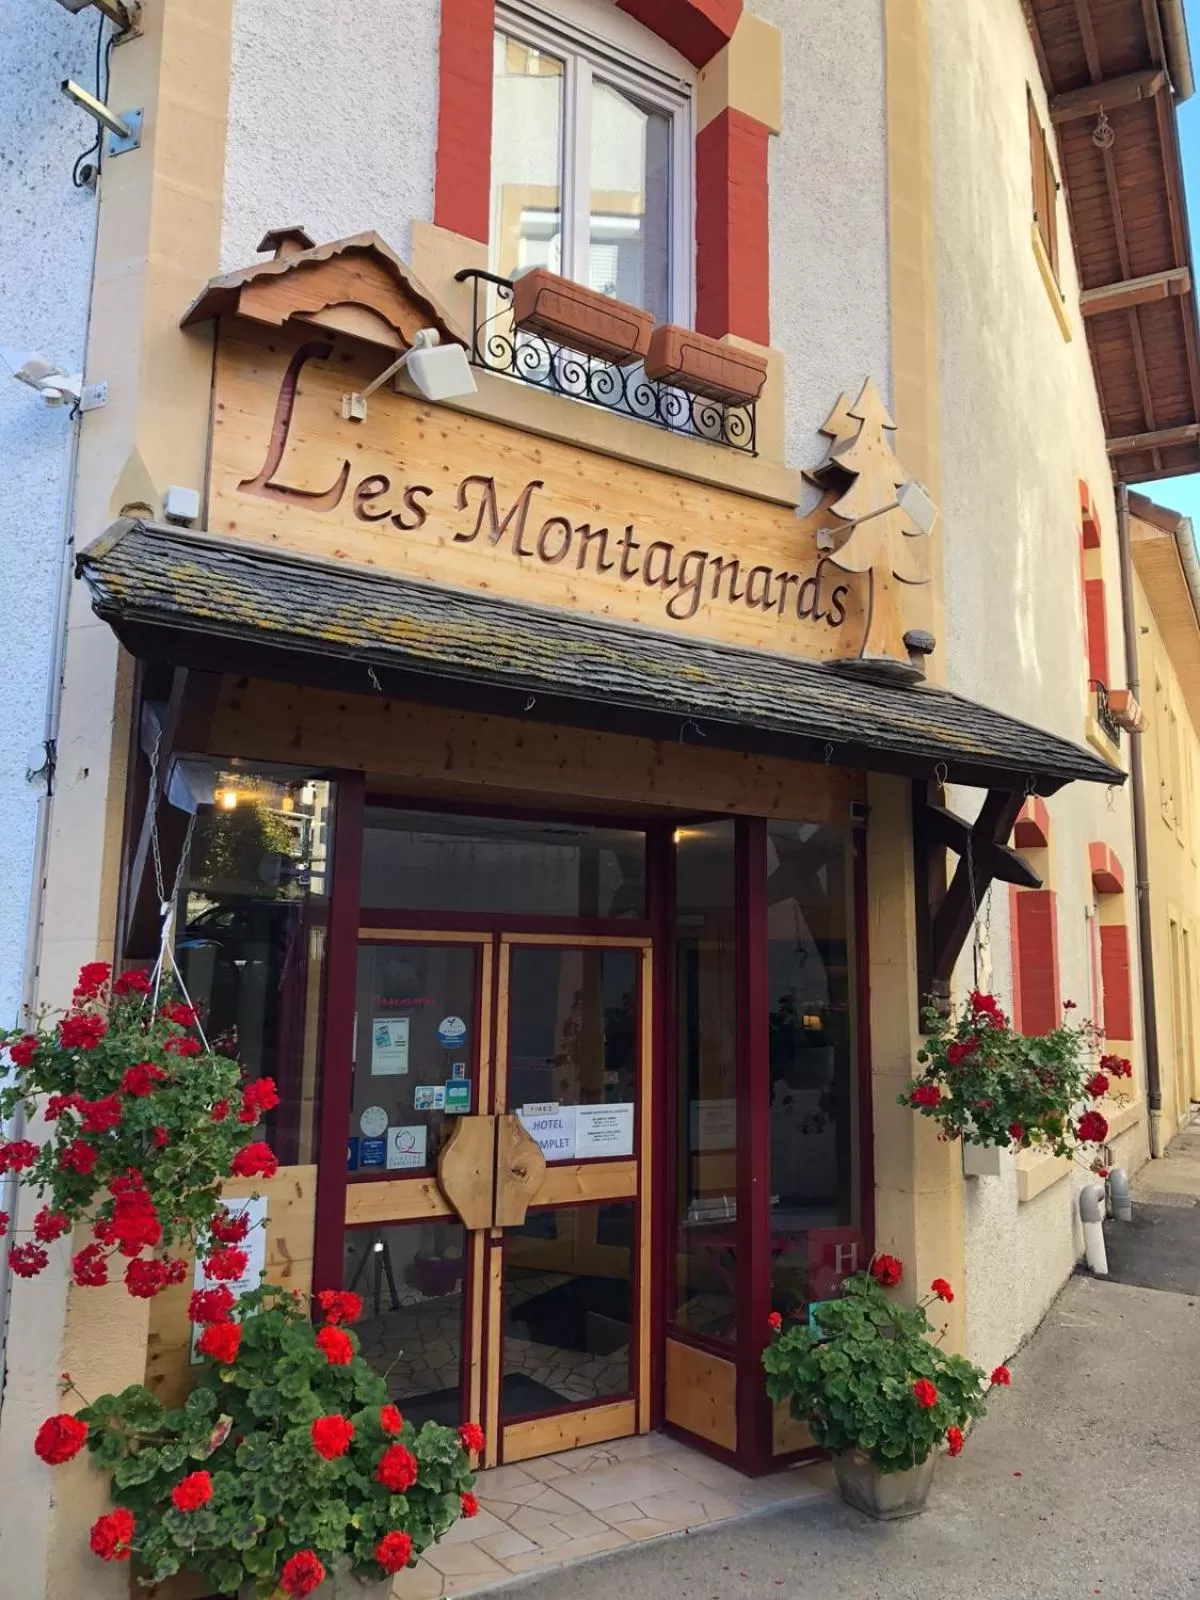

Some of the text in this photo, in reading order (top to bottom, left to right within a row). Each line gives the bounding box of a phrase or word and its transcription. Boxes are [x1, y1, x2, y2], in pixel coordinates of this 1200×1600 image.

[237, 340, 850, 628] Les Montagnards
[533, 1119, 564, 1131] HOTEL
[539, 1138, 570, 1150] MPLET
[834, 1242, 858, 1274] H
